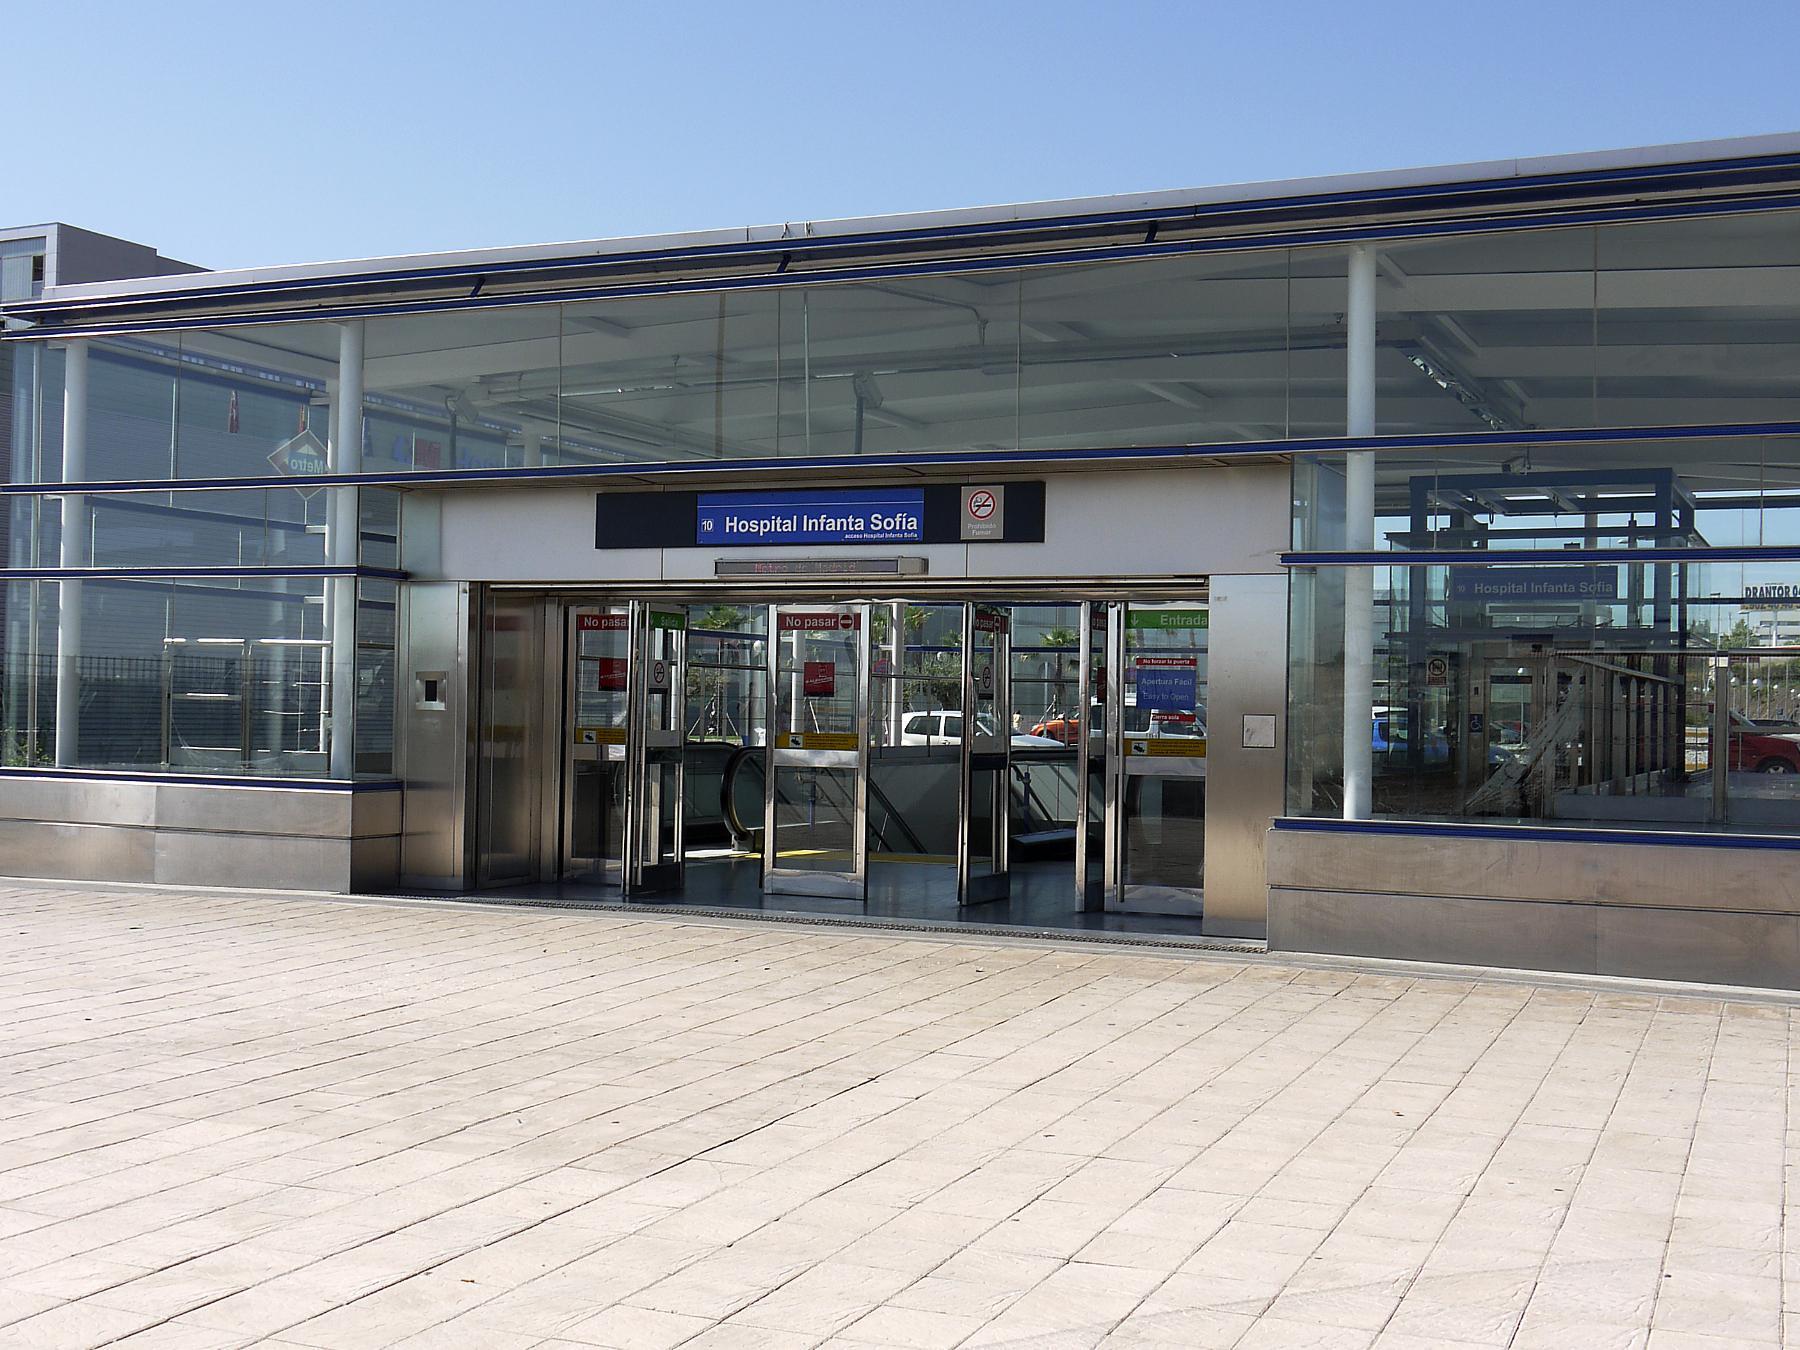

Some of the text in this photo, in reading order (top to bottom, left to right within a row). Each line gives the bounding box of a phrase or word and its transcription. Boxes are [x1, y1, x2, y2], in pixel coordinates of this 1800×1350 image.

[702, 520, 713, 531] 10
[725, 512, 918, 536] Hospital Infanta Sofía
[1474, 582, 1527, 595] Hospital
[1531, 582, 1575, 593] Infanta
[584, 616, 598, 626] No
[785, 616, 837, 629] No pasar
[1160, 614, 1207, 626] Entrada
[1141, 678, 1173, 686] Apertura
